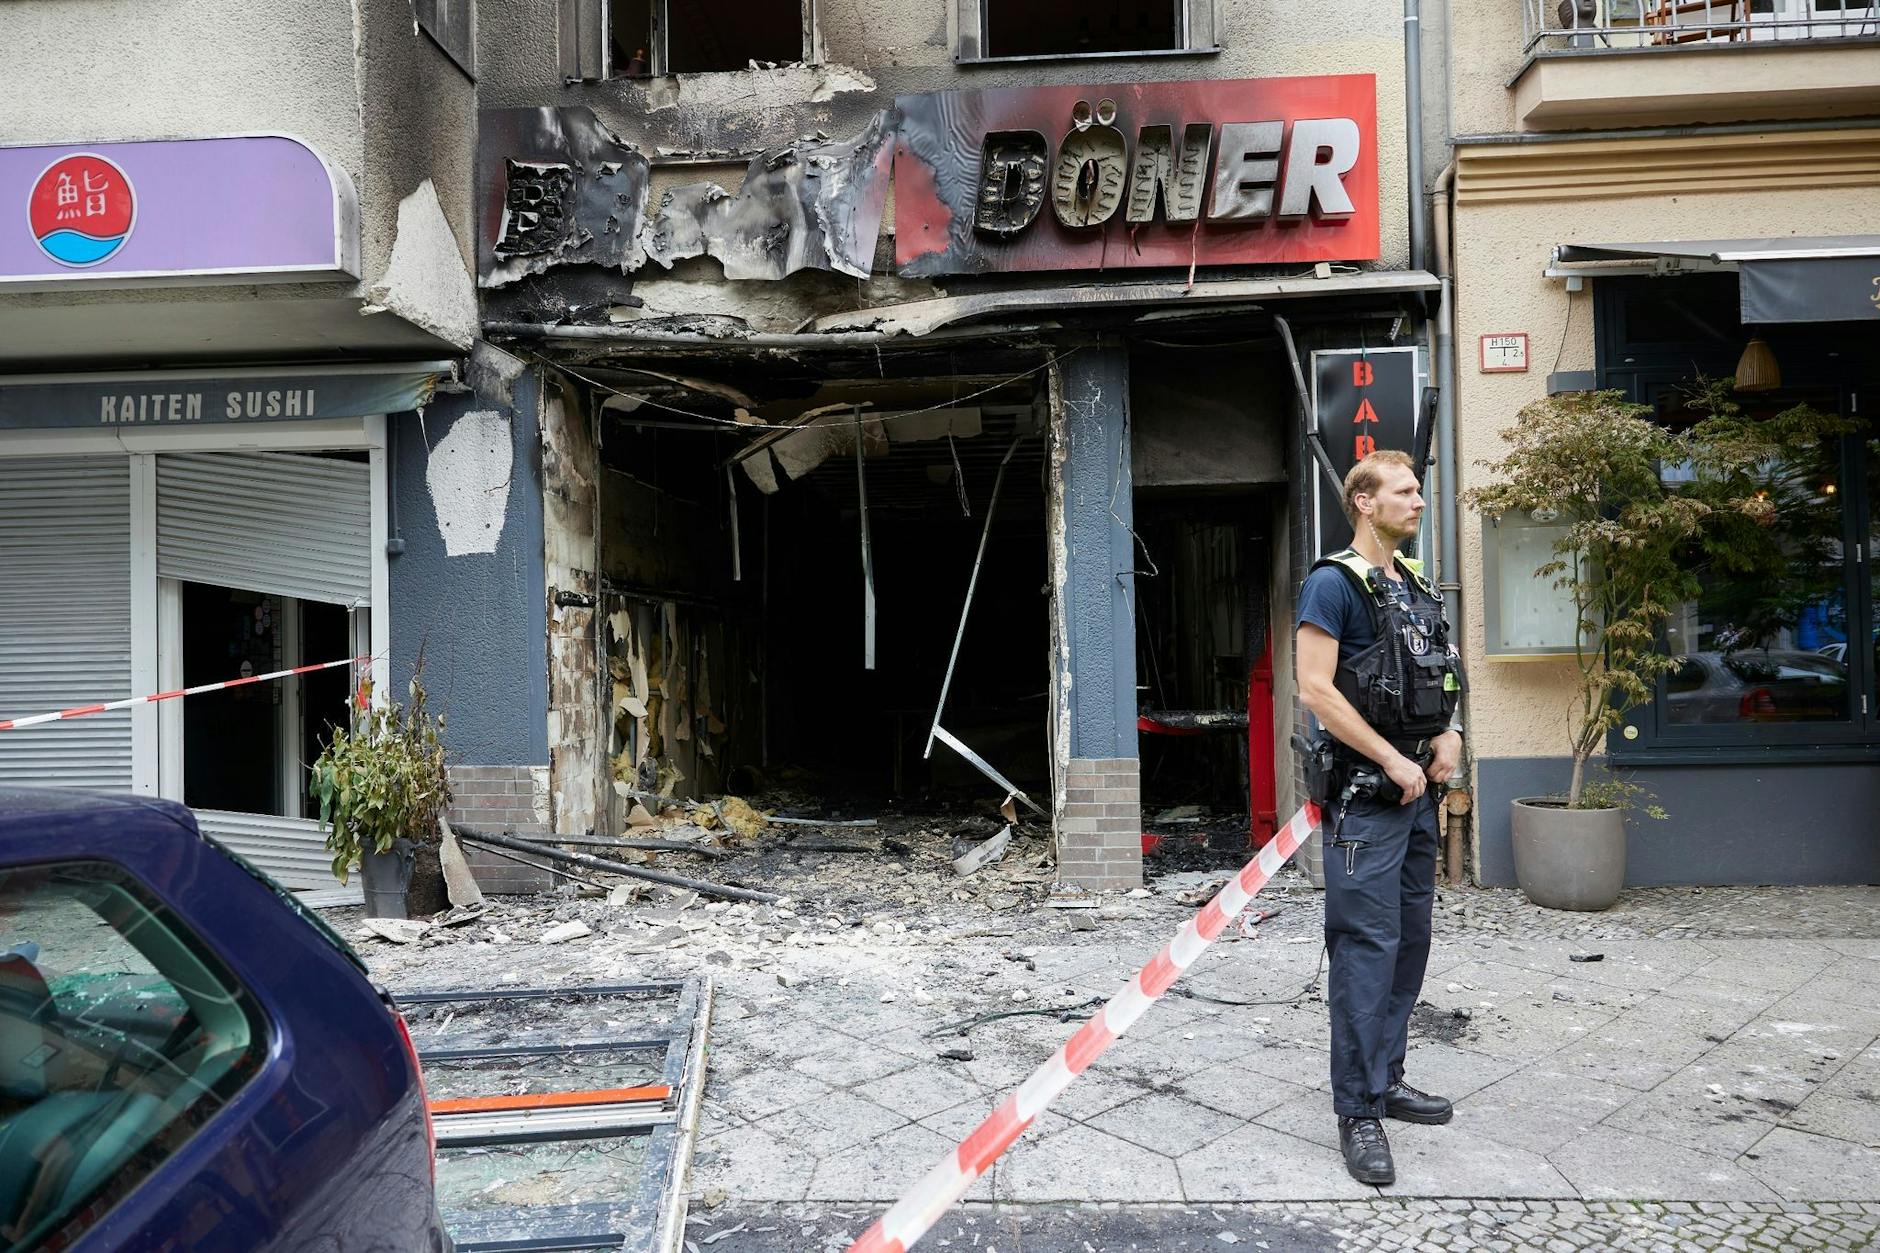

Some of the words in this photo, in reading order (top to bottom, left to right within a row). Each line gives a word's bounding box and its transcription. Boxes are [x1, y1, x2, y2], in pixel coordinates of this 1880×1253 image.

[974, 97, 1360, 235] DÖNER
[55, 170, 109, 220] 鮨
[101, 393, 202, 423] KAITEN
[226, 389, 315, 419] SUSHI
